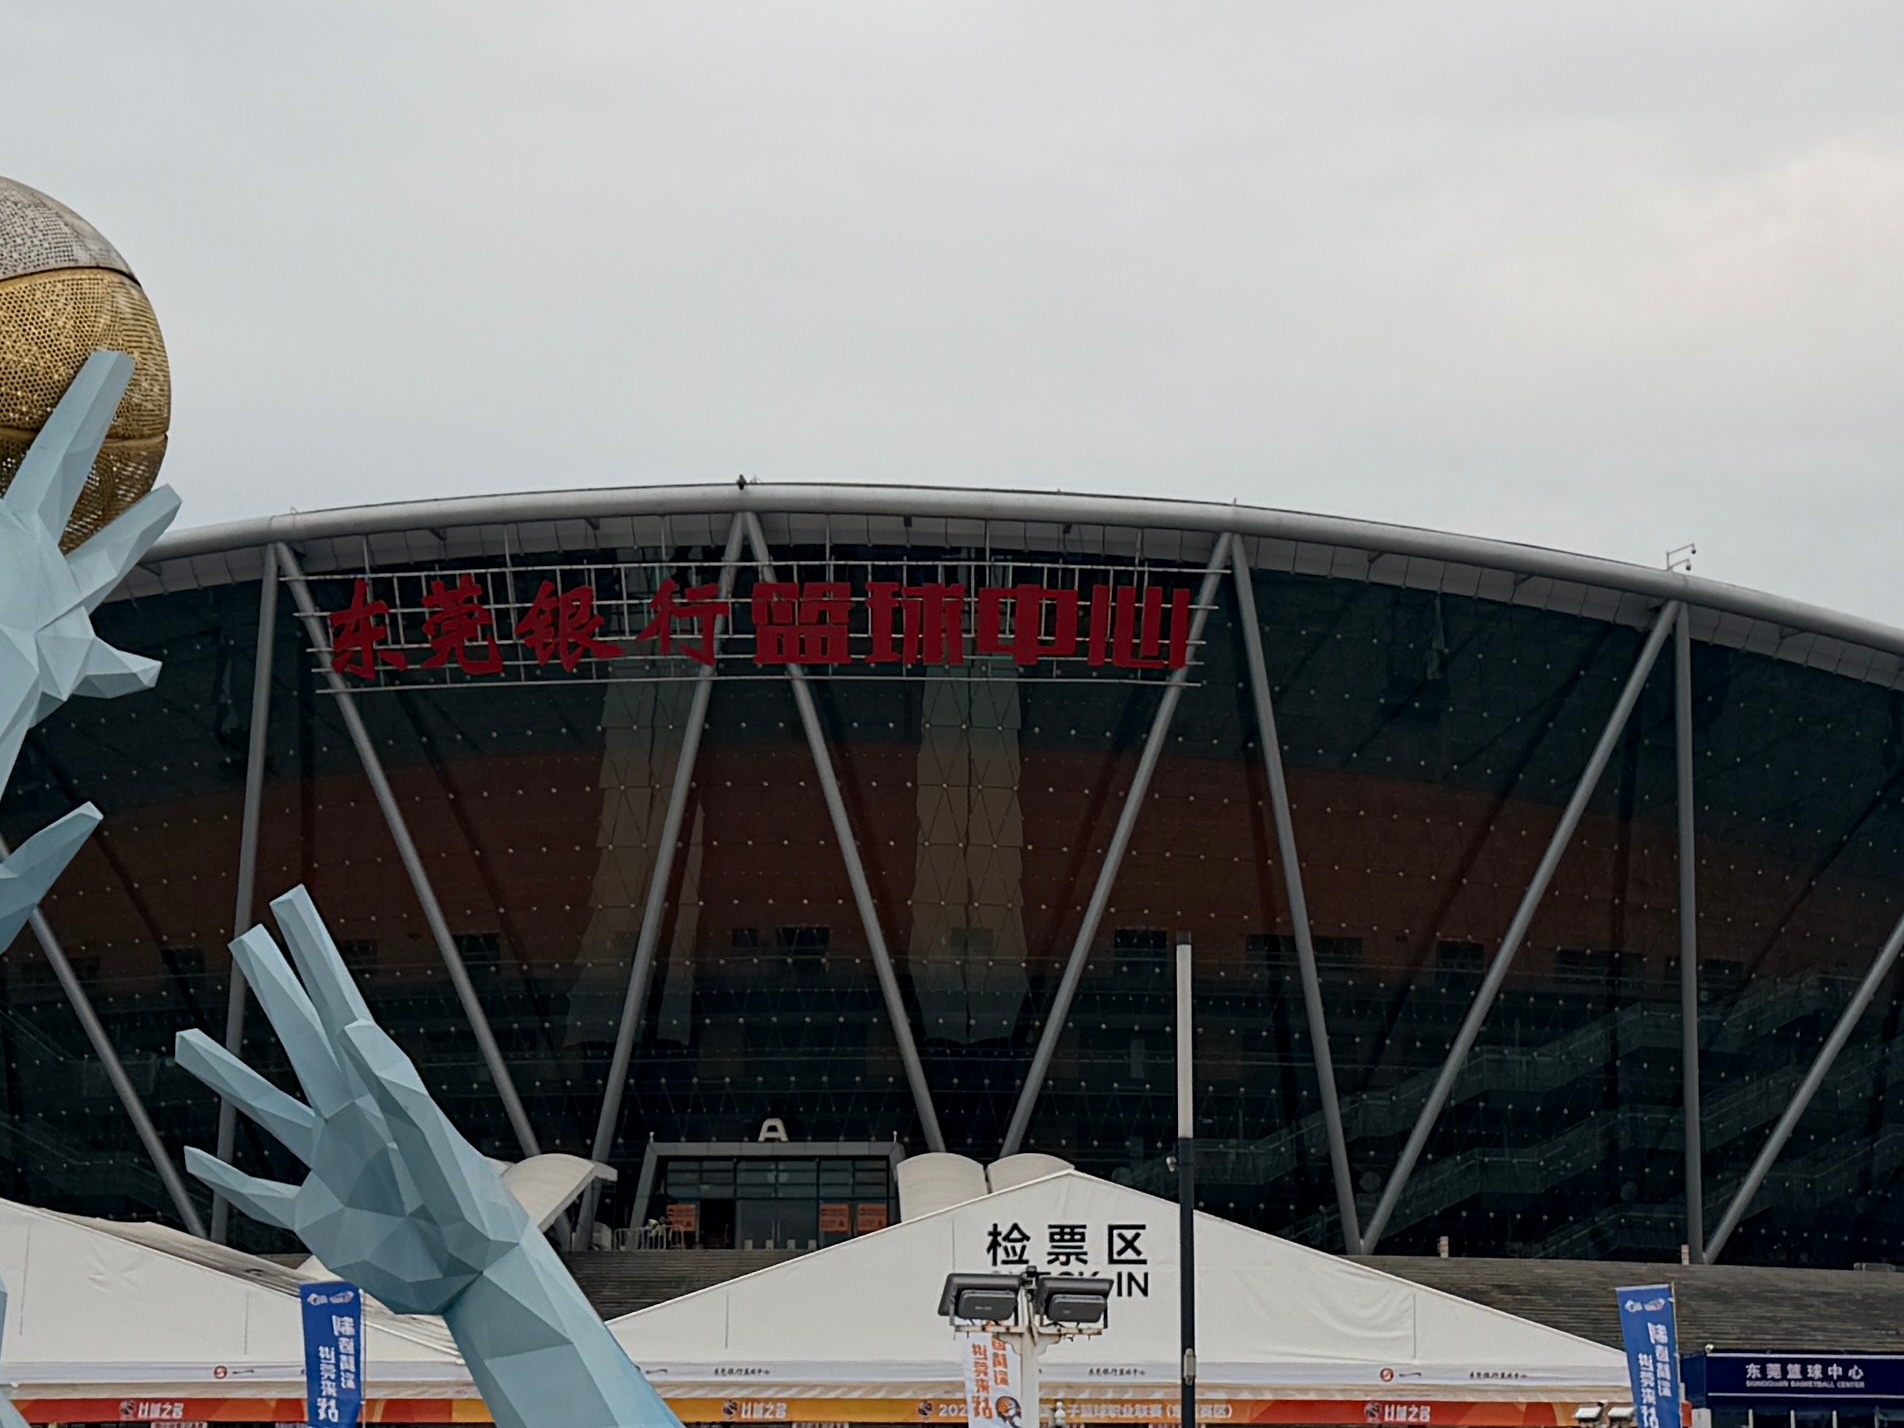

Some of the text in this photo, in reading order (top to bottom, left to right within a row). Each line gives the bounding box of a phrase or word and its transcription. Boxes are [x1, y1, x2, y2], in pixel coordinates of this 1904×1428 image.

[329, 572, 1190, 680] 东莞银行篮球中心
[757, 1117, 789, 1142] A
[986, 1222, 1148, 1267] 检票区
[1116, 1271, 1149, 1297] IN
[1745, 1363, 1864, 1380] 东莞篮球中心
